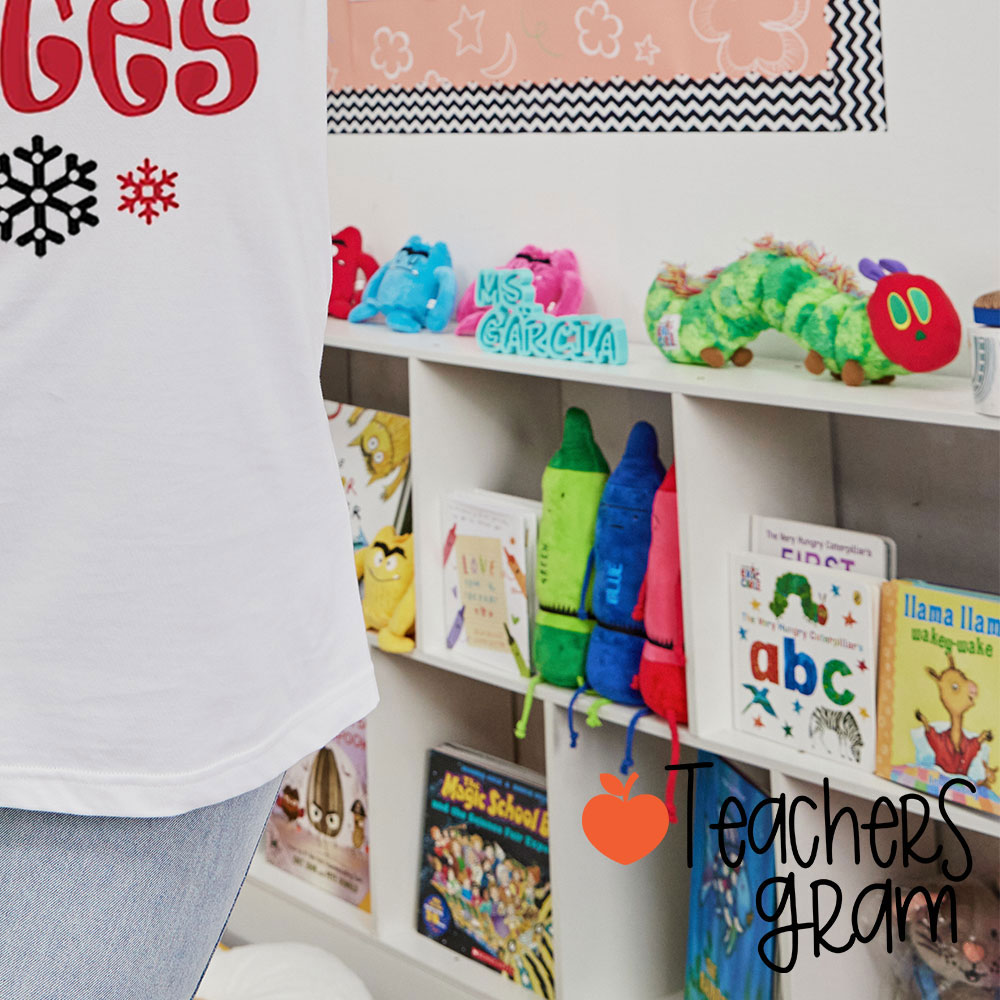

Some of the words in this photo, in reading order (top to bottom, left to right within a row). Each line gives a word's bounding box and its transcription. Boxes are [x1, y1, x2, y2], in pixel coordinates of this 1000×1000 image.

[606, 562, 623, 605] BLUE
[904, 593, 955, 628] llama
[749, 636, 856, 706] abc
[441, 771, 488, 811] Magic
[487, 788, 541, 833] School
